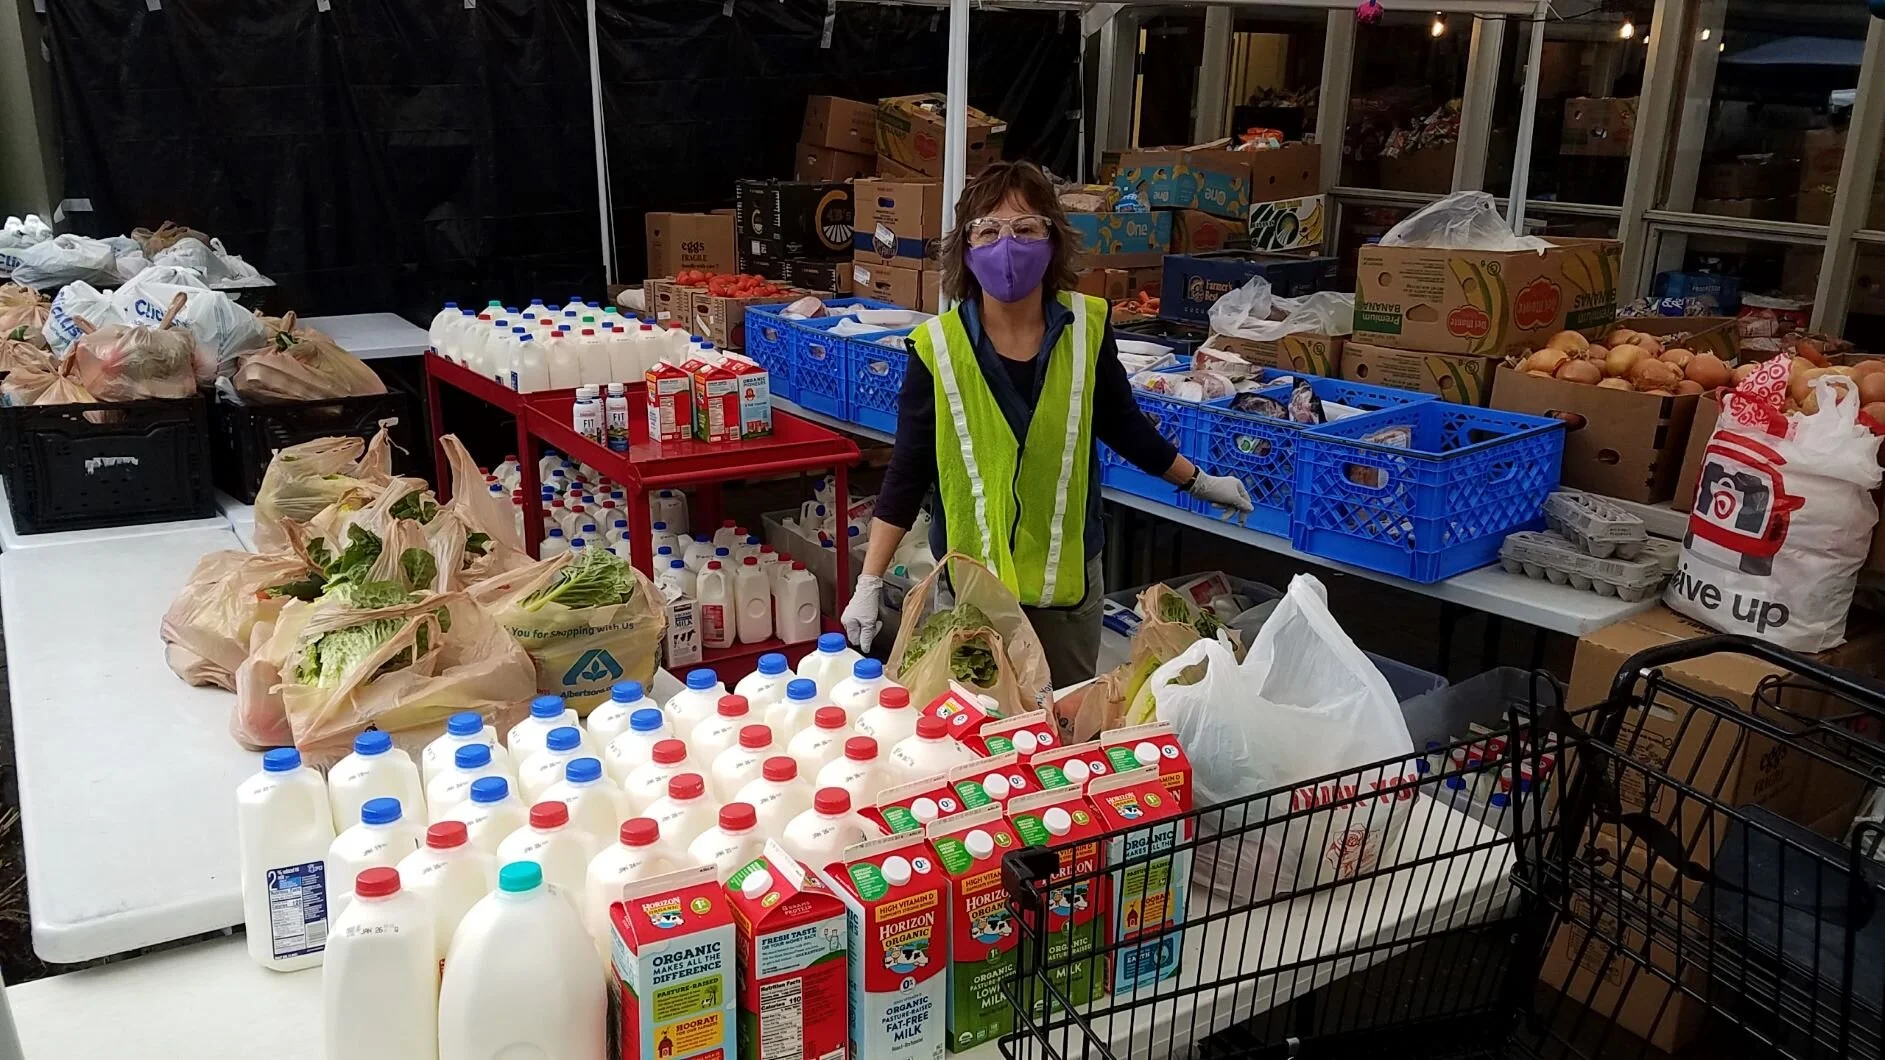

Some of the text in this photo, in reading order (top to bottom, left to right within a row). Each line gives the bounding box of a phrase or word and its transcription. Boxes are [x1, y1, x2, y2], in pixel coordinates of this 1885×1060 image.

[1204, 188, 1226, 206] One
[1126, 220, 1148, 237] One
[681, 241, 705, 254] eggs
[1206, 279, 1233, 291] Farmer's
[1362, 312, 1400, 326] Premium
[583, 419, 594, 428] FIT
[613, 412, 625, 421] FIT
[1732, 594, 1790, 634] up
[511, 626, 530, 638] You
[533, 629, 548, 639] for
[597, 622, 619, 634] with
[1105, 792, 1137, 805] HORIZON
[268, 871, 278, 891] 2
[966, 876, 983, 887] HIGH
[641, 896, 681, 912] HORIZON
[879, 904, 898, 915] HIGH
[899, 894, 928, 909] VITAMIN
[966, 888, 1011, 913] HORIZO
[360, 926, 373, 935] JAN
[374, 926, 384, 934] 26
[879, 910, 935, 941] HORIZON
[761, 926, 817, 946] FRESH TASTE
[885, 928, 930, 948] ORGANIC
[652, 941, 721, 967] ORGANIC
[1048, 937, 1089, 954] ORGNIC
[653, 951, 721, 976] MAKES ALL THE
[1056, 962, 1082, 979] MLK
[652, 961, 722, 985] DIFFERENCE
[973, 964, 1013, 984] ORGANIC
[656, 977, 719, 998] PASTURE-RAISED
[761, 982, 786, 992] Nutrition
[761, 996, 801, 1010] Calories 110
[886, 996, 929, 1016] ORGANIC
[981, 991, 1008, 1009] MILK
[881, 1002, 933, 1024] PASTURE-RAISED
[886, 1011, 929, 1033] FAT-FREE
[676, 1014, 719, 1032] HOORAY!
[894, 1023, 922, 1042] MILK
